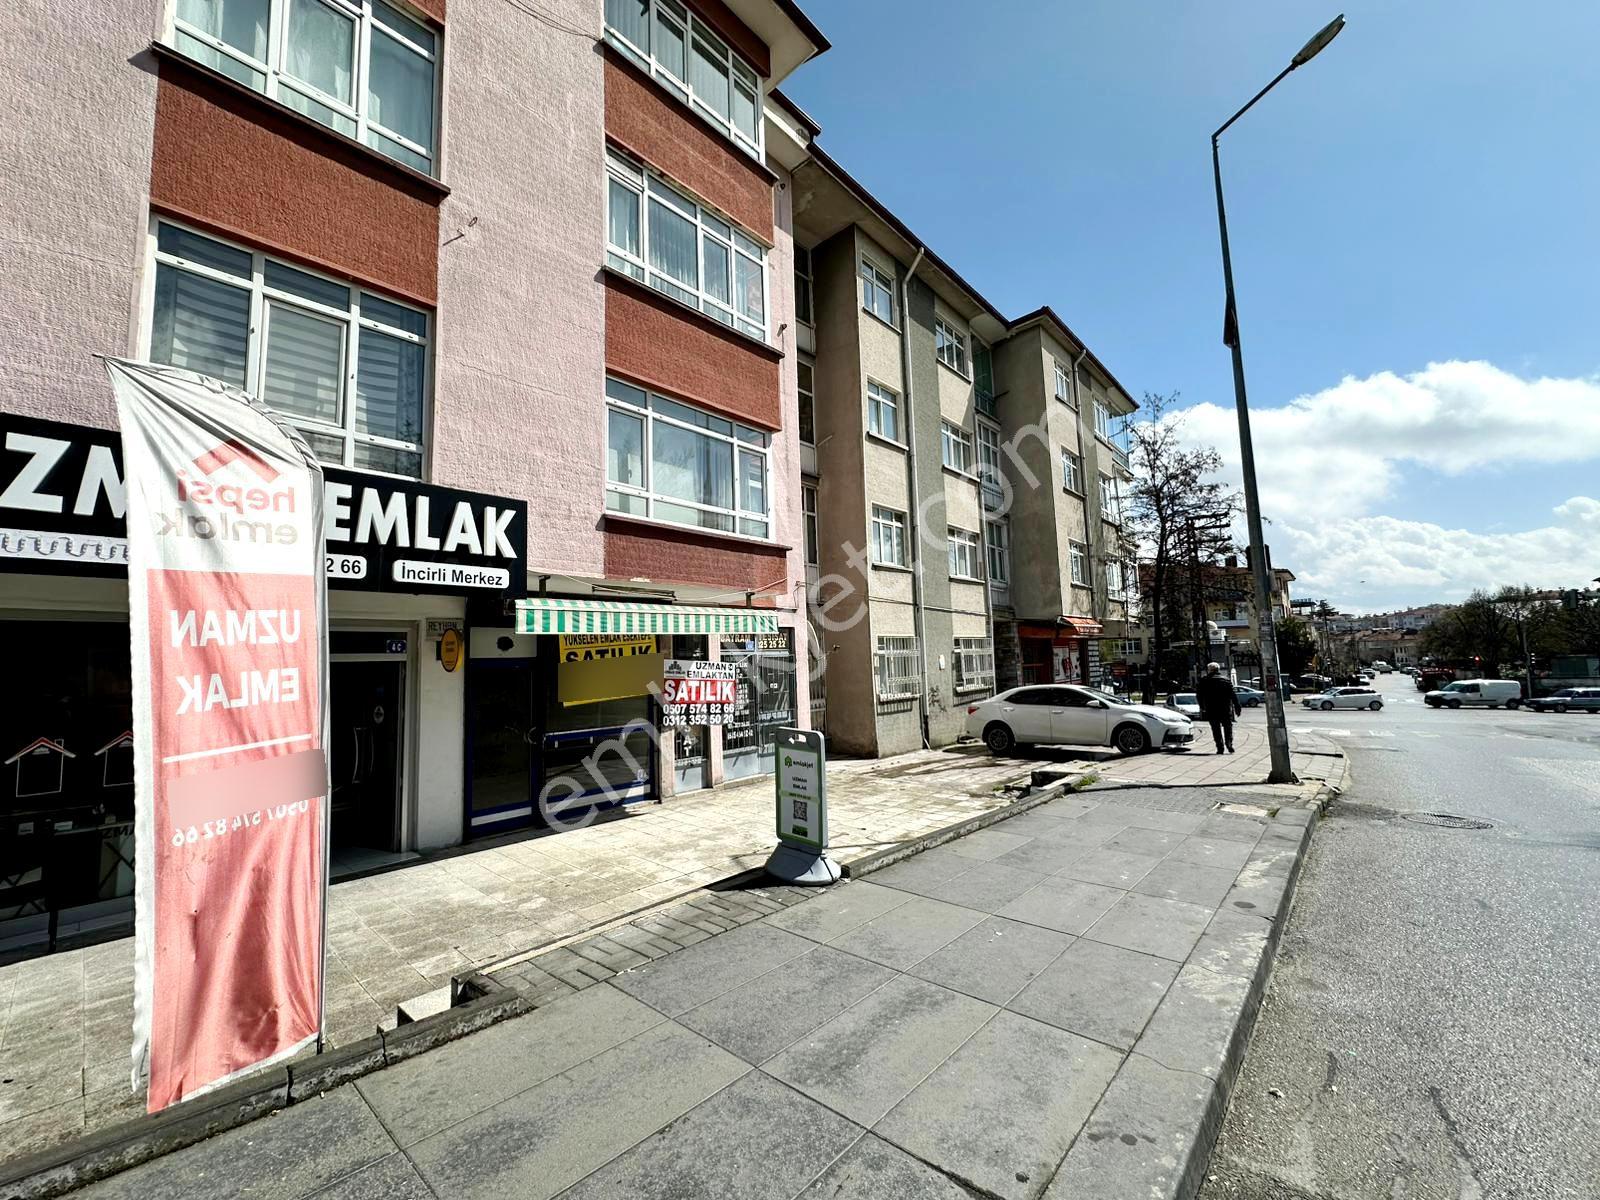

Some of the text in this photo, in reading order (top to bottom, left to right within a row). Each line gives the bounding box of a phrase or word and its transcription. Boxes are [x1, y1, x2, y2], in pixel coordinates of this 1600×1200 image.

[325, 481, 517, 559] EMLAK
[340, 560, 362, 575] 66
[401, 561, 446, 583] İncirli
[451, 569, 503, 586] Merkez
[778, 640, 786, 648] 22
[696, 662, 726, 671] UZMAN
[687, 671, 734, 679] EMLAKTAN
[664, 680, 735, 702] SATILIK
[663, 704, 687, 714] 0507
[689, 704, 707, 714] 574
[710, 704, 721, 713] 82
[724, 703, 735, 713] 66
[663, 714, 734, 726] 0312 352 50 20
